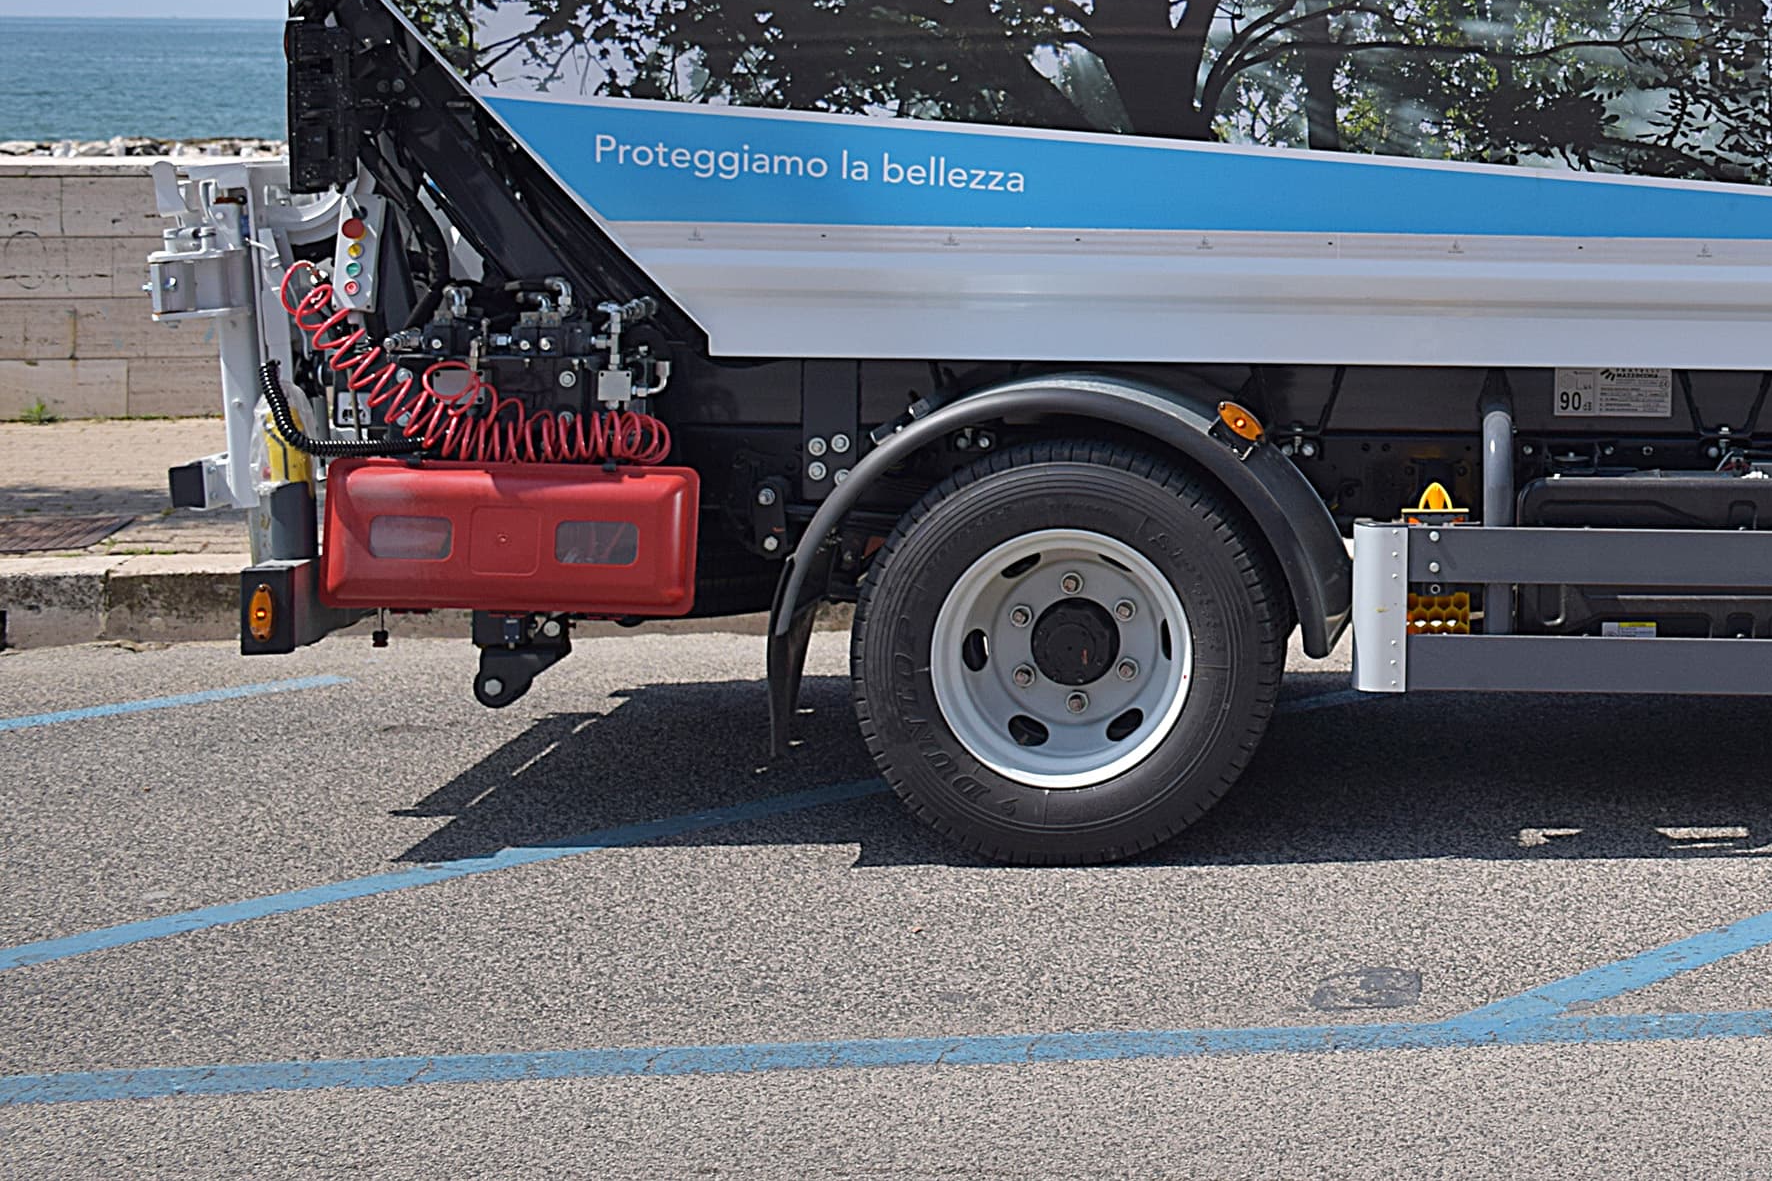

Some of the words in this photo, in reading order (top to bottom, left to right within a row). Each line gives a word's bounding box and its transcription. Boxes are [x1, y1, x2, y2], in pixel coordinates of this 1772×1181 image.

[594, 133, 829, 180] Proteggiamo
[840, 149, 870, 182] la
[881, 152, 1027, 193] bellezza
[1559, 391, 1582, 411] 90
